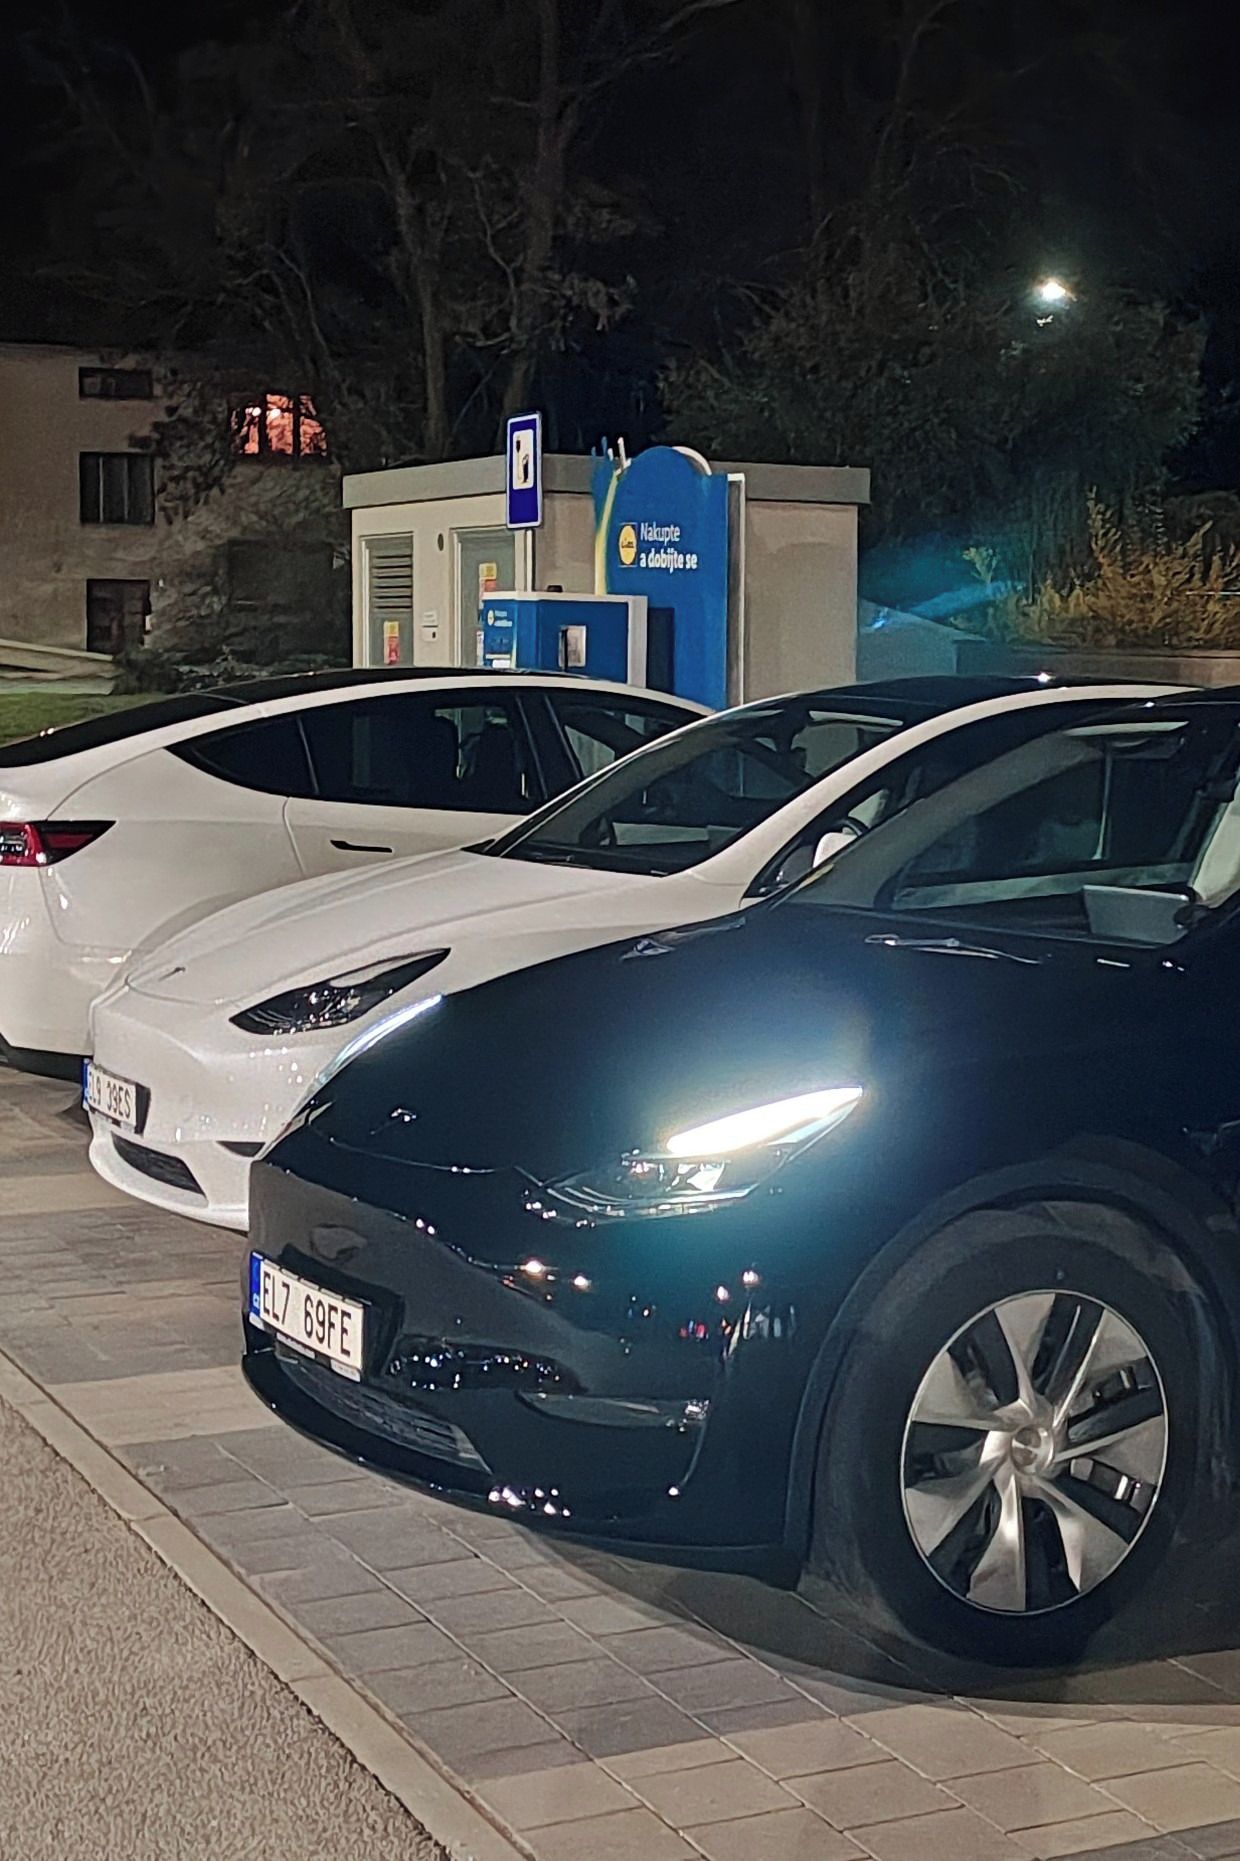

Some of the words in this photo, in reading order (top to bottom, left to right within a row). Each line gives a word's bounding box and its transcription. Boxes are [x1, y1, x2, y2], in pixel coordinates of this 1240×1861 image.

[640, 521, 680, 546] Nakupte
[640, 553, 647, 568] a
[686, 553, 698, 569] se
[263, 1270, 290, 1326] EL7
[304, 1294, 352, 1359] 69FE
